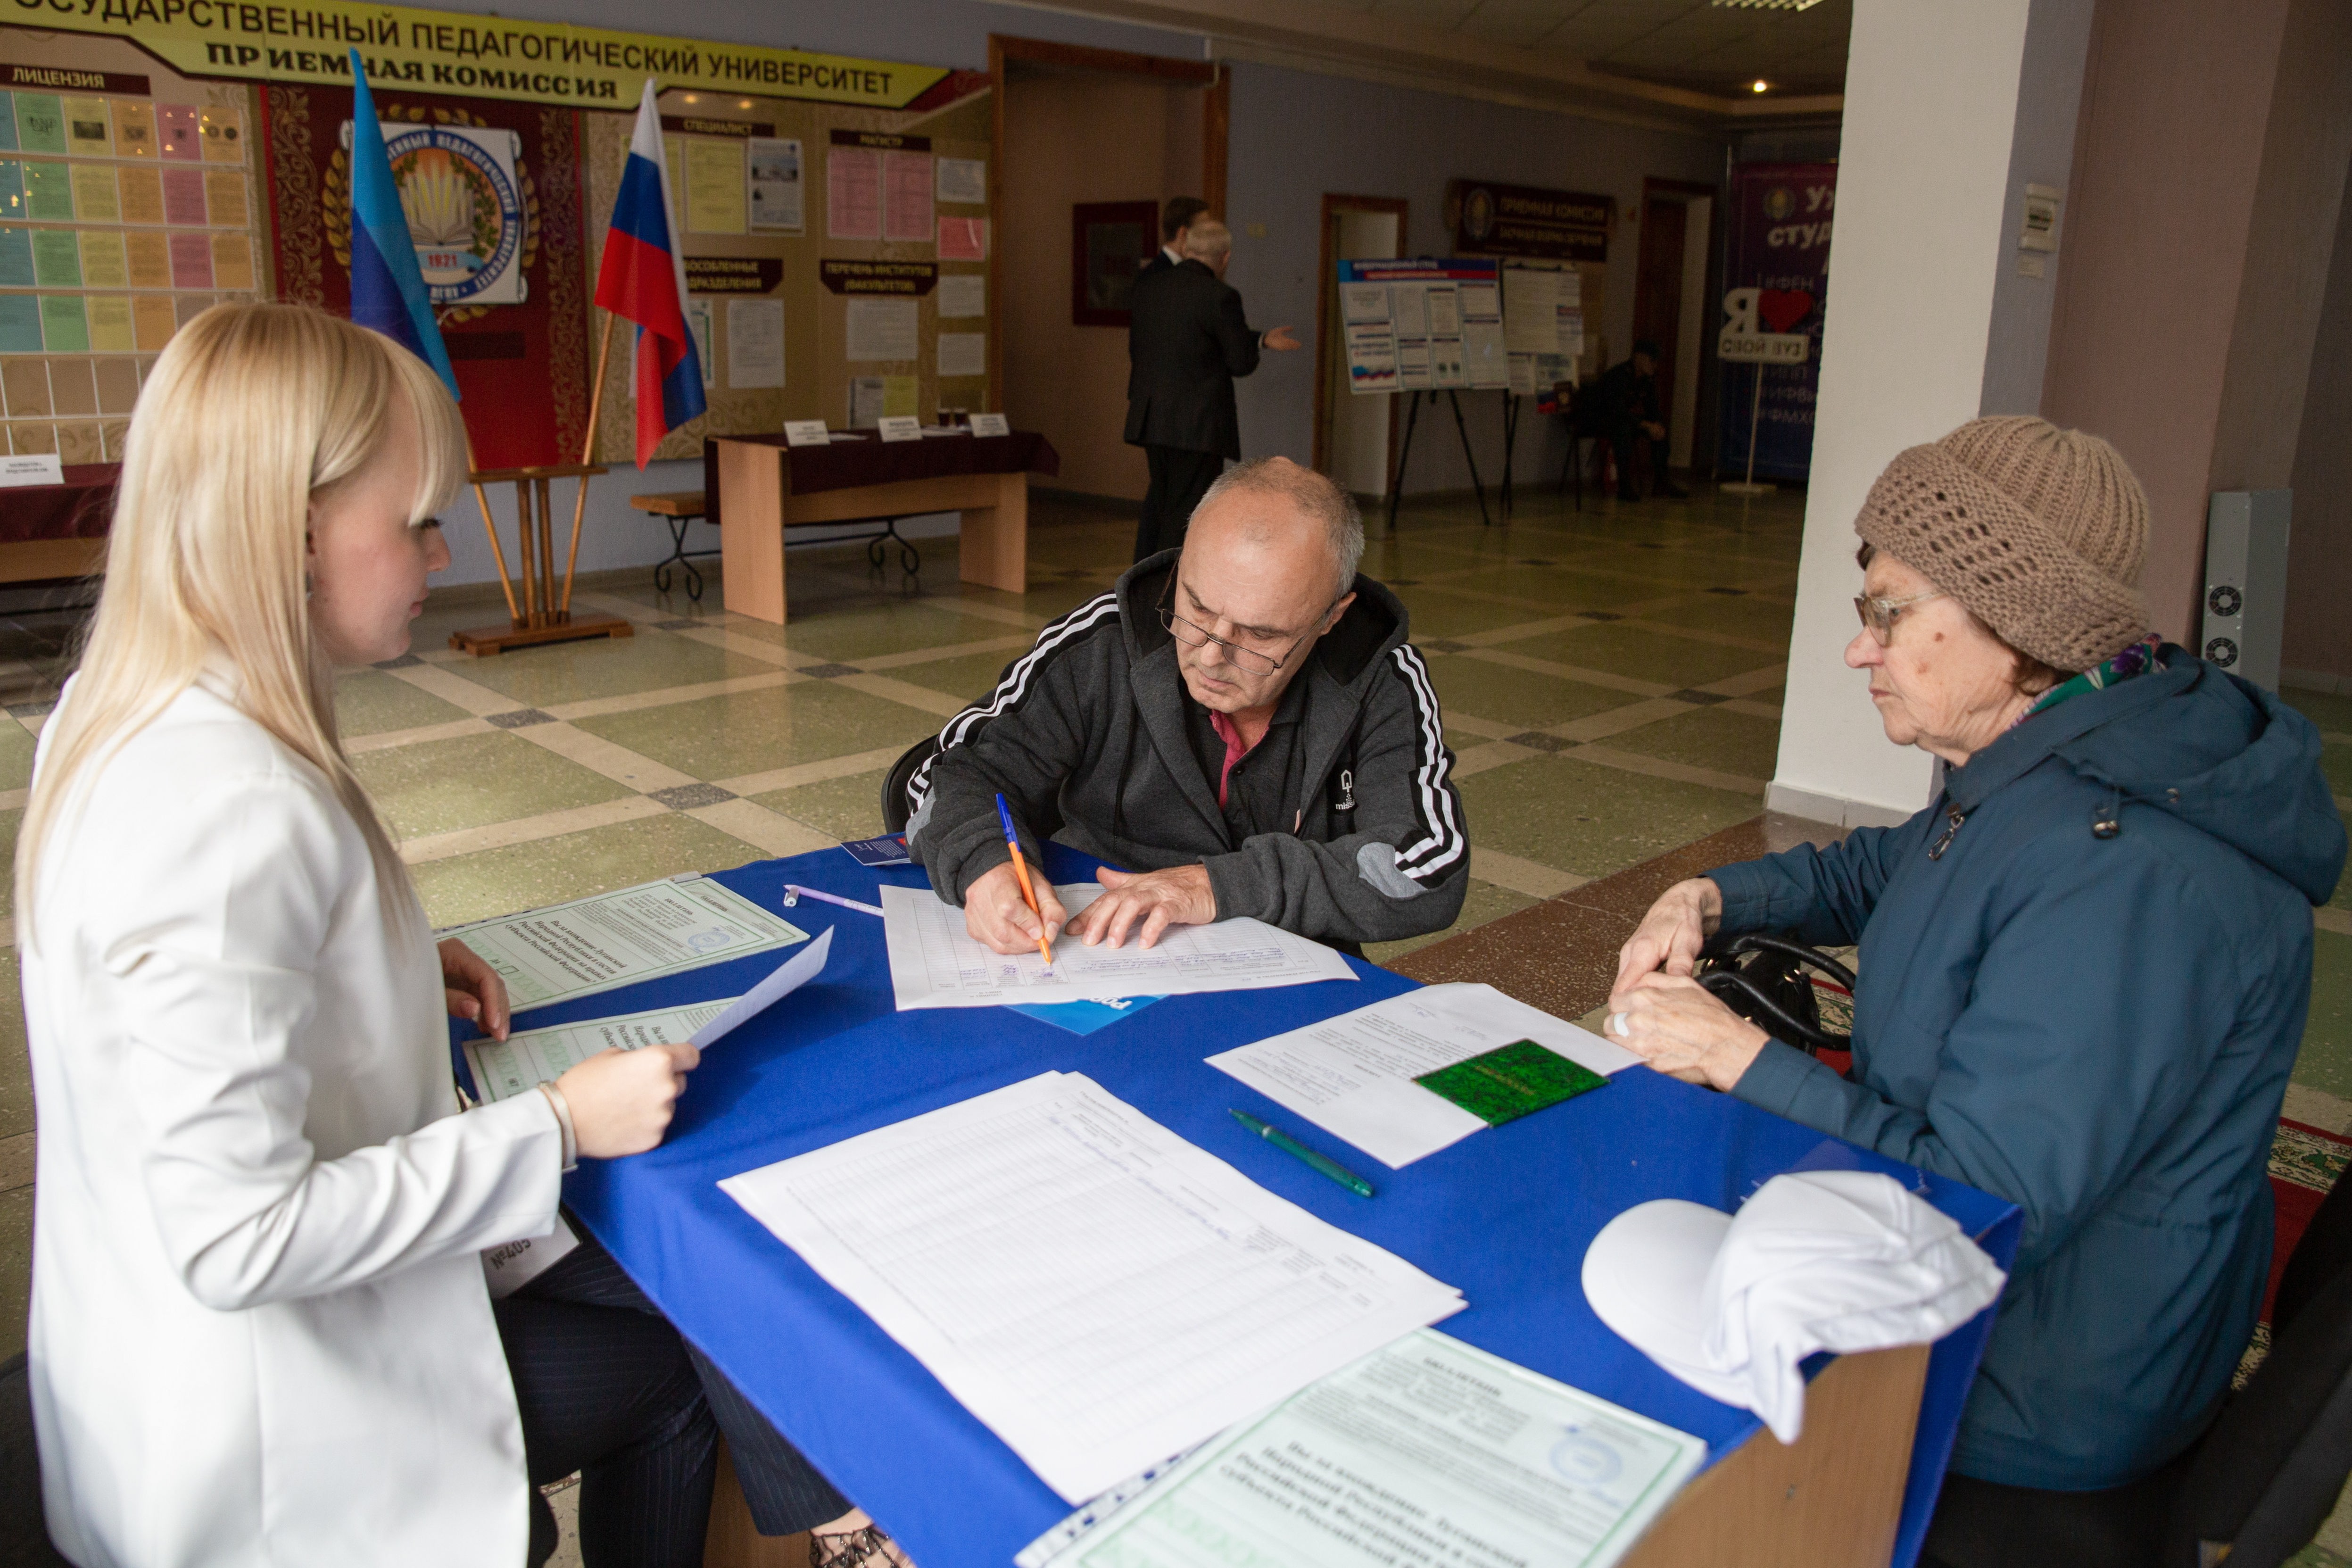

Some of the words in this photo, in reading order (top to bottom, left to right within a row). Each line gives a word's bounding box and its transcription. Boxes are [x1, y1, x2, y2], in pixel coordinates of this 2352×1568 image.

[12, 67, 106, 89] ЛИЦЕНЗИЯ
[205, 42, 425, 82] ПРИЕМНАЯ
[433, 63, 618, 100] КОМИССИЯ
[412, 24, 700, 75] ПЕДАГОГИЧЕСКИЙ
[707, 53, 892, 95] УНИВЕРСИТЕТ
[1721, 287, 1761, 334] Я
[505, 923, 533, 942] субъекта
[530, 940, 563, 962] Российской
[558, 960, 596, 983] Федерации?
[519, 921, 554, 942] Российской
[547, 941, 582, 963] Федерации
[584, 965, 608, 980] правах
[535, 920, 564, 939] Народной
[561, 937, 596, 961] Республики
[596, 961, 618, 975] состав
[564, 929, 596, 949] вхождение
[594, 948, 628, 969] Луганской
[616, 1024, 637, 1050] Российско
[652, 1026, 661, 1034] Вы
